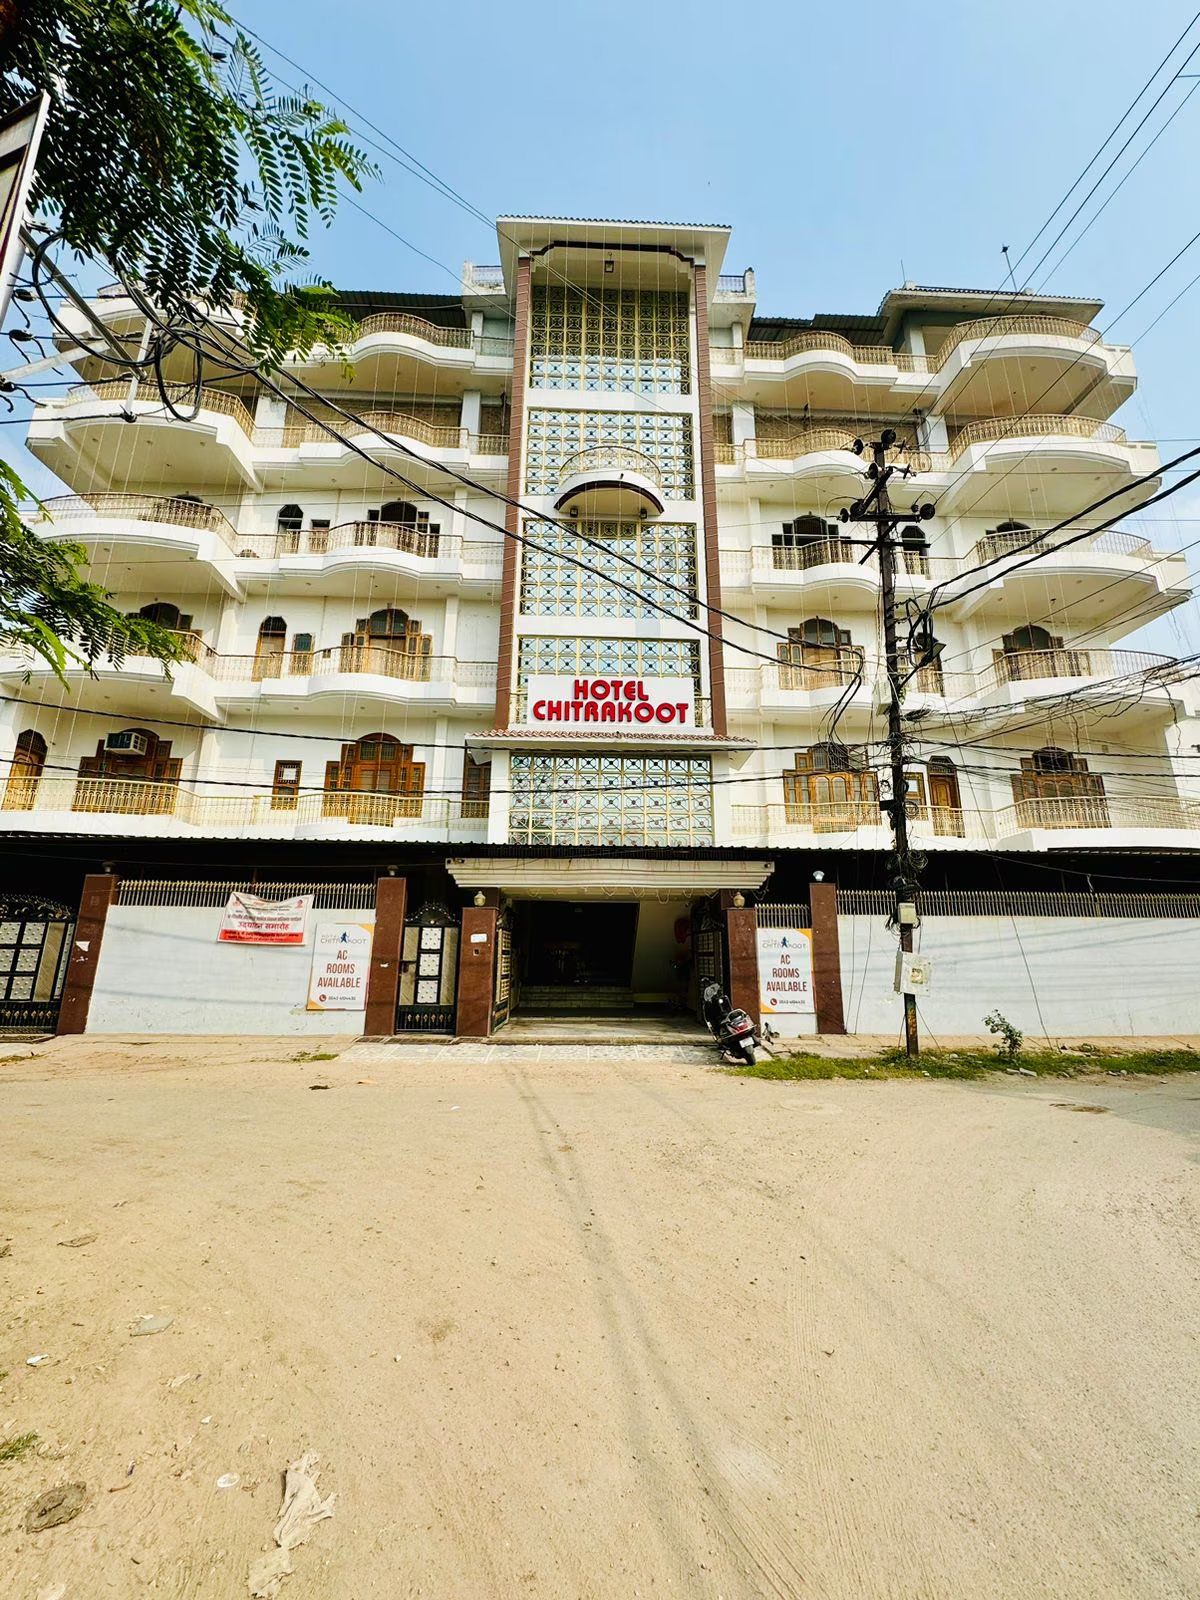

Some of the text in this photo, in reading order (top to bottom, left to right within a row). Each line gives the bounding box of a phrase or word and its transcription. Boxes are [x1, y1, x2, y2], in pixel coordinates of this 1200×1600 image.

[574, 679, 649, 701] HOTEL
[532, 700, 689, 723] CHITRAKOOT
[336, 950, 348, 961] AC
[780, 954, 791, 965] AC
[326, 963, 356, 974] ROOMS
[772, 968, 800, 978] ROOMS
[317, 977, 361, 988] AVAILABLE
[766, 981, 808, 992] AVAILABLE
